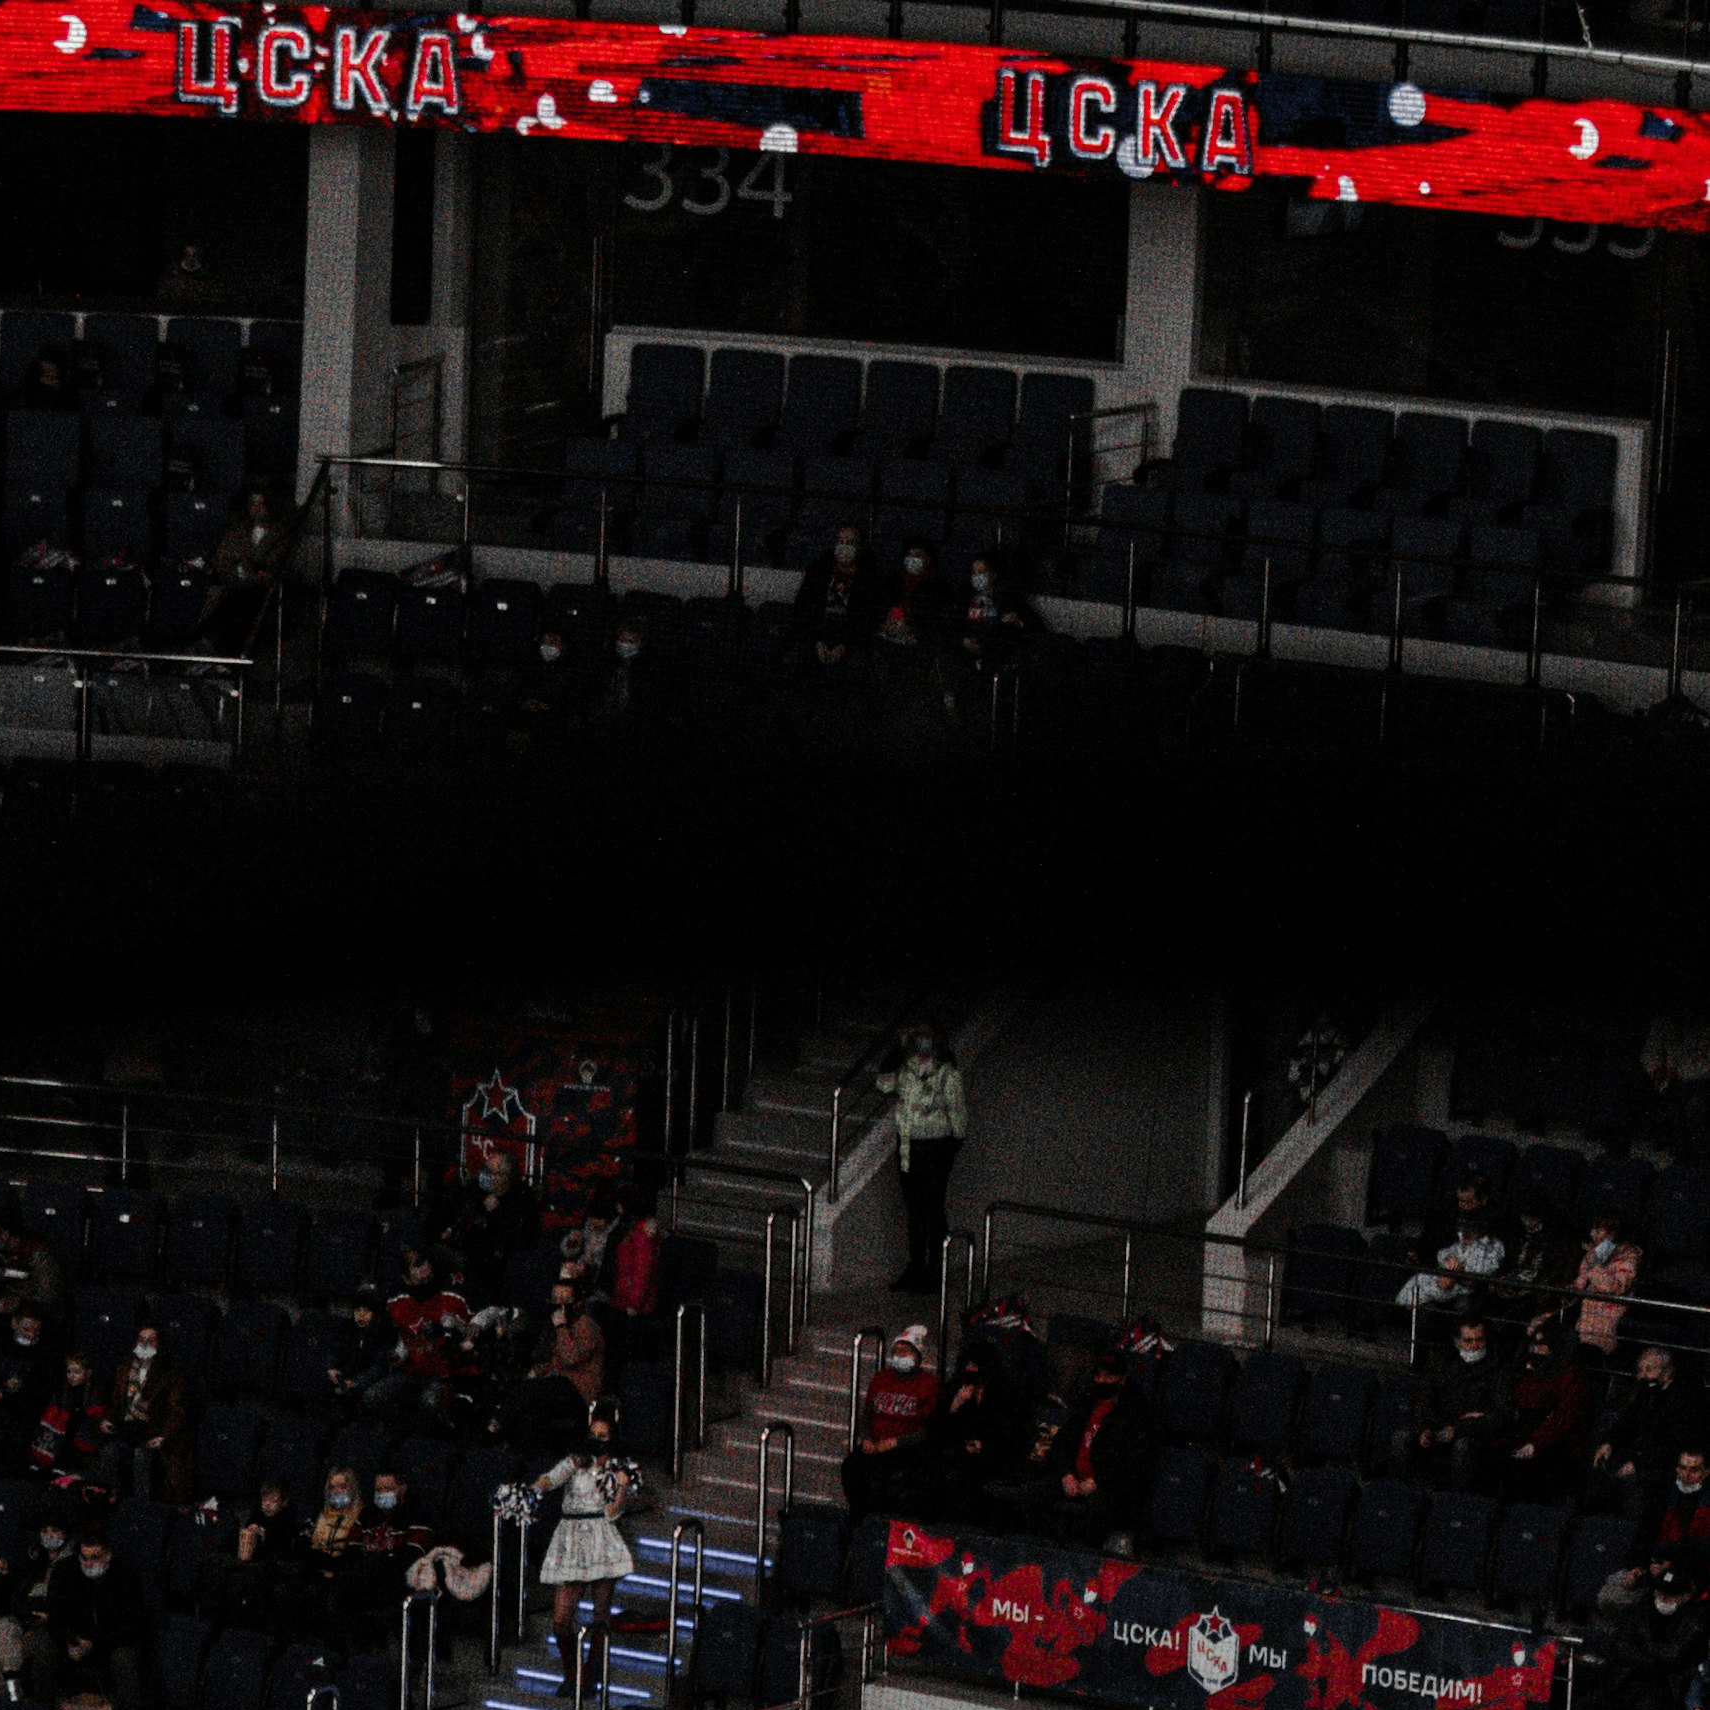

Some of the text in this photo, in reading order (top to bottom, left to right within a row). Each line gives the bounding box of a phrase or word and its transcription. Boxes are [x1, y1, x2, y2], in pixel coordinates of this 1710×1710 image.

[178, 21, 461, 119] ЦСКА
[996, 66, 1254, 175] ЦСКА
[624, 143, 793, 218] 334
[992, 1598, 1030, 1624] МЫ
[1113, 1620, 1181, 1651] ЦСКА!
[1248, 1643, 1287, 1670] МЫ
[1361, 1663, 1482, 1704] ПОБЕДИМ!
[1196, 1640, 1228, 1673] ЦСКА
